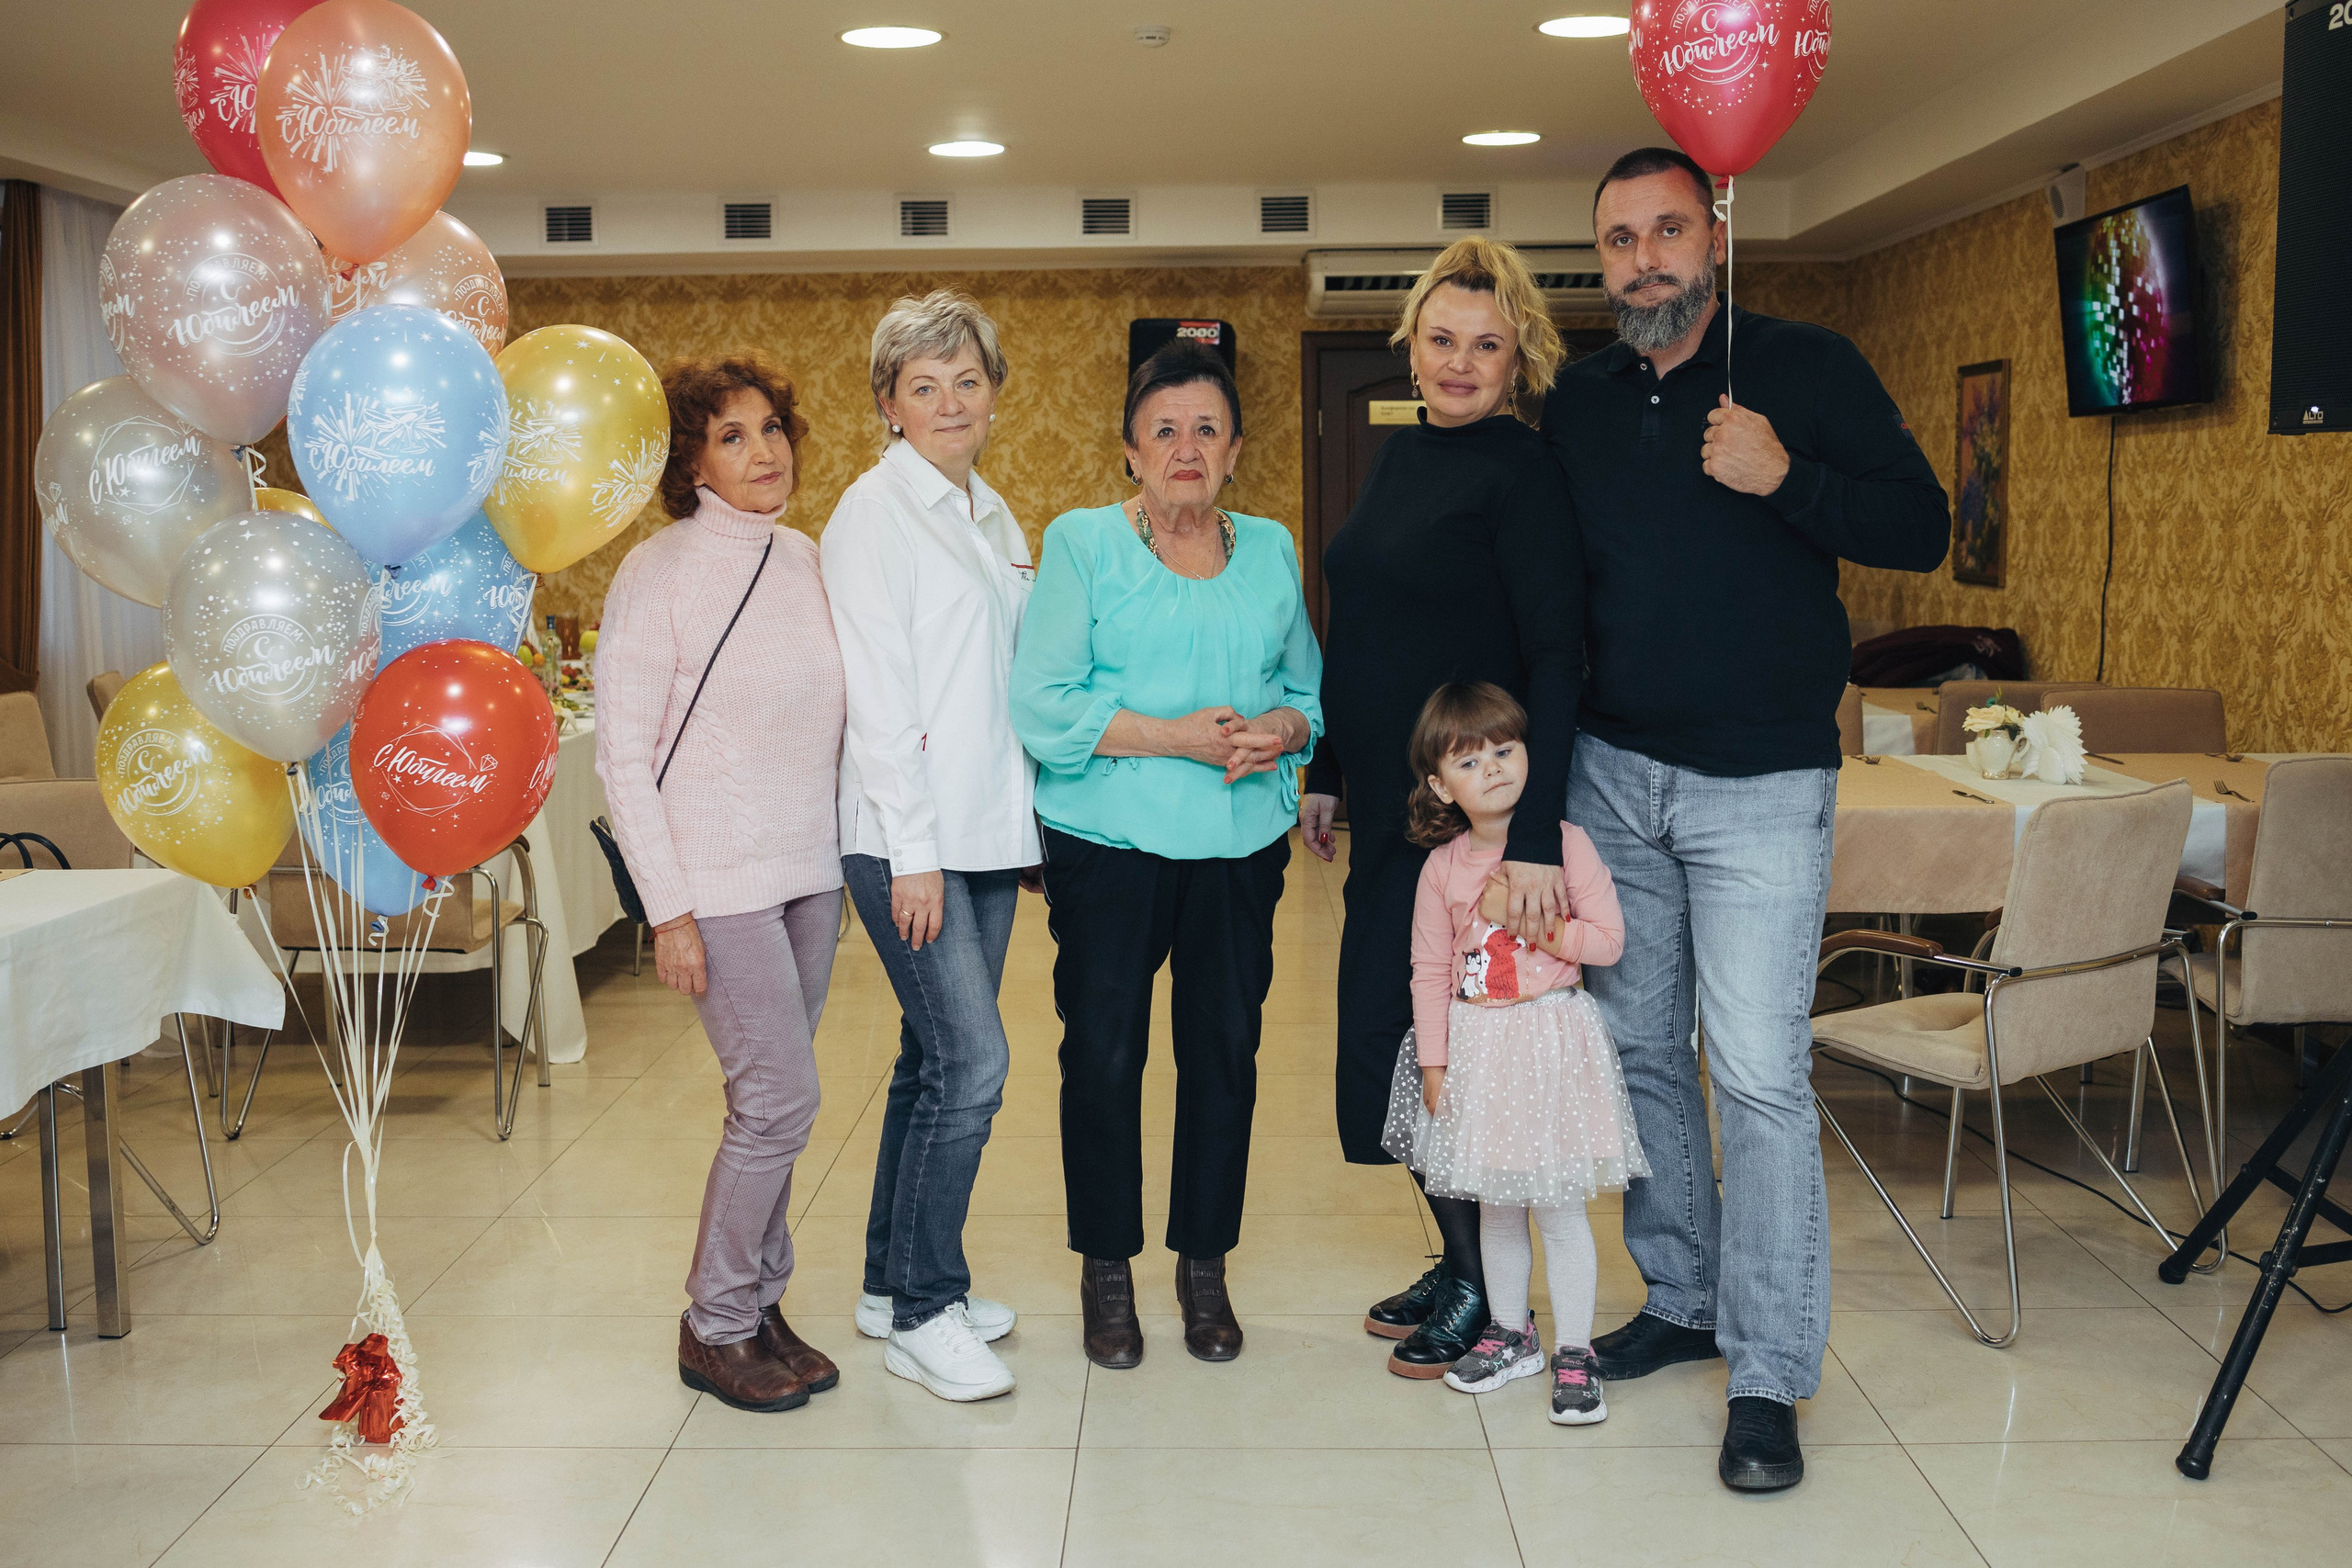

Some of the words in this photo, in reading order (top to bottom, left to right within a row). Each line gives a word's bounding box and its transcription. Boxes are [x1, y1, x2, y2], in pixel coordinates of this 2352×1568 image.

[1659, 21, 1781, 76] Юбилеем
[297, 105, 421, 143] Юбилеем
[166, 285, 300, 347] Юбилеем
[105, 435, 202, 495] Юбилеем
[322, 441, 435, 477] Юбилеем
[223, 618, 303, 654] ПОЗДРАВЛЯЕМ
[209, 645, 336, 694] Юбилеем
[118, 733, 175, 774] ПОЗДРАВЛЯЕМ
[387, 746, 492, 794] Юбилеем
[117, 744, 212, 817] Юбилеем
